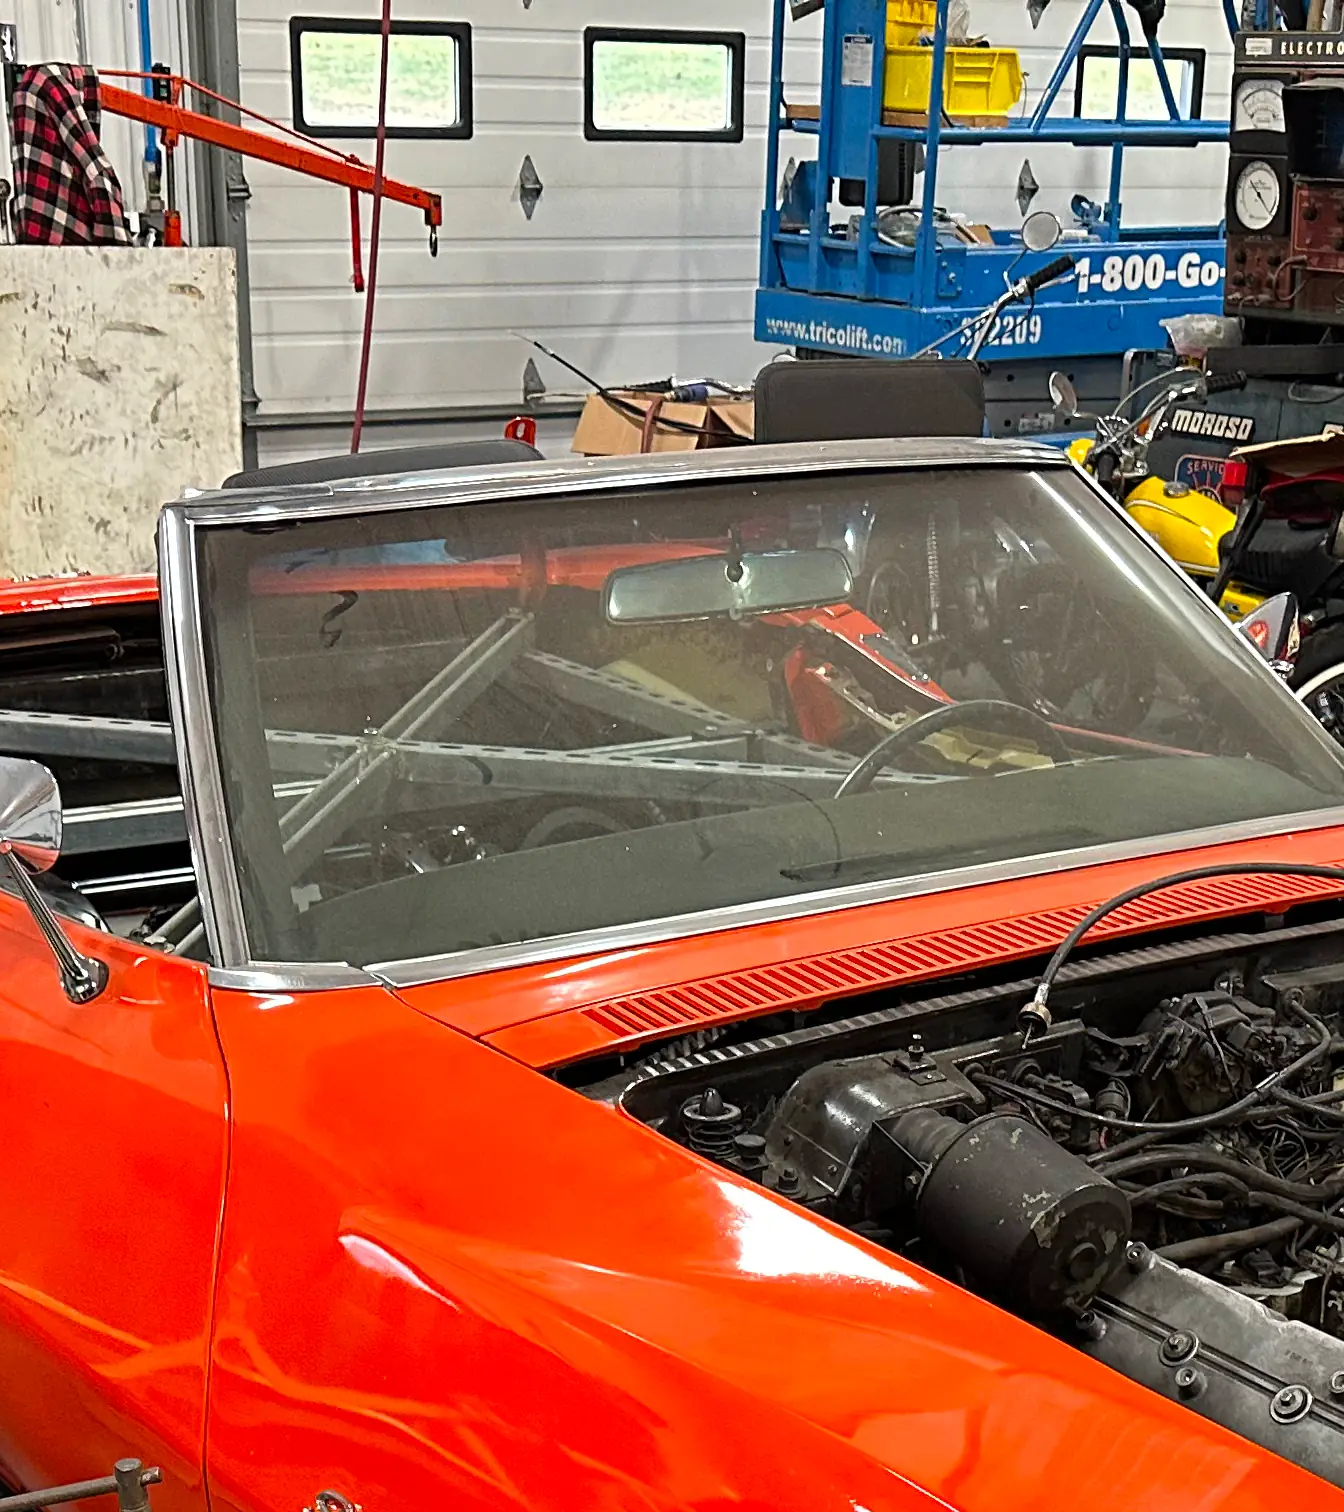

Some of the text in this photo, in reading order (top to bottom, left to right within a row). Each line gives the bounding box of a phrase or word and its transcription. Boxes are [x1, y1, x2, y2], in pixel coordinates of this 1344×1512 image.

[766, 316, 908, 356] www.tricolift.com
[959, 314, 1042, 347] S2209
[1171, 408, 1254, 441] MOROSO
